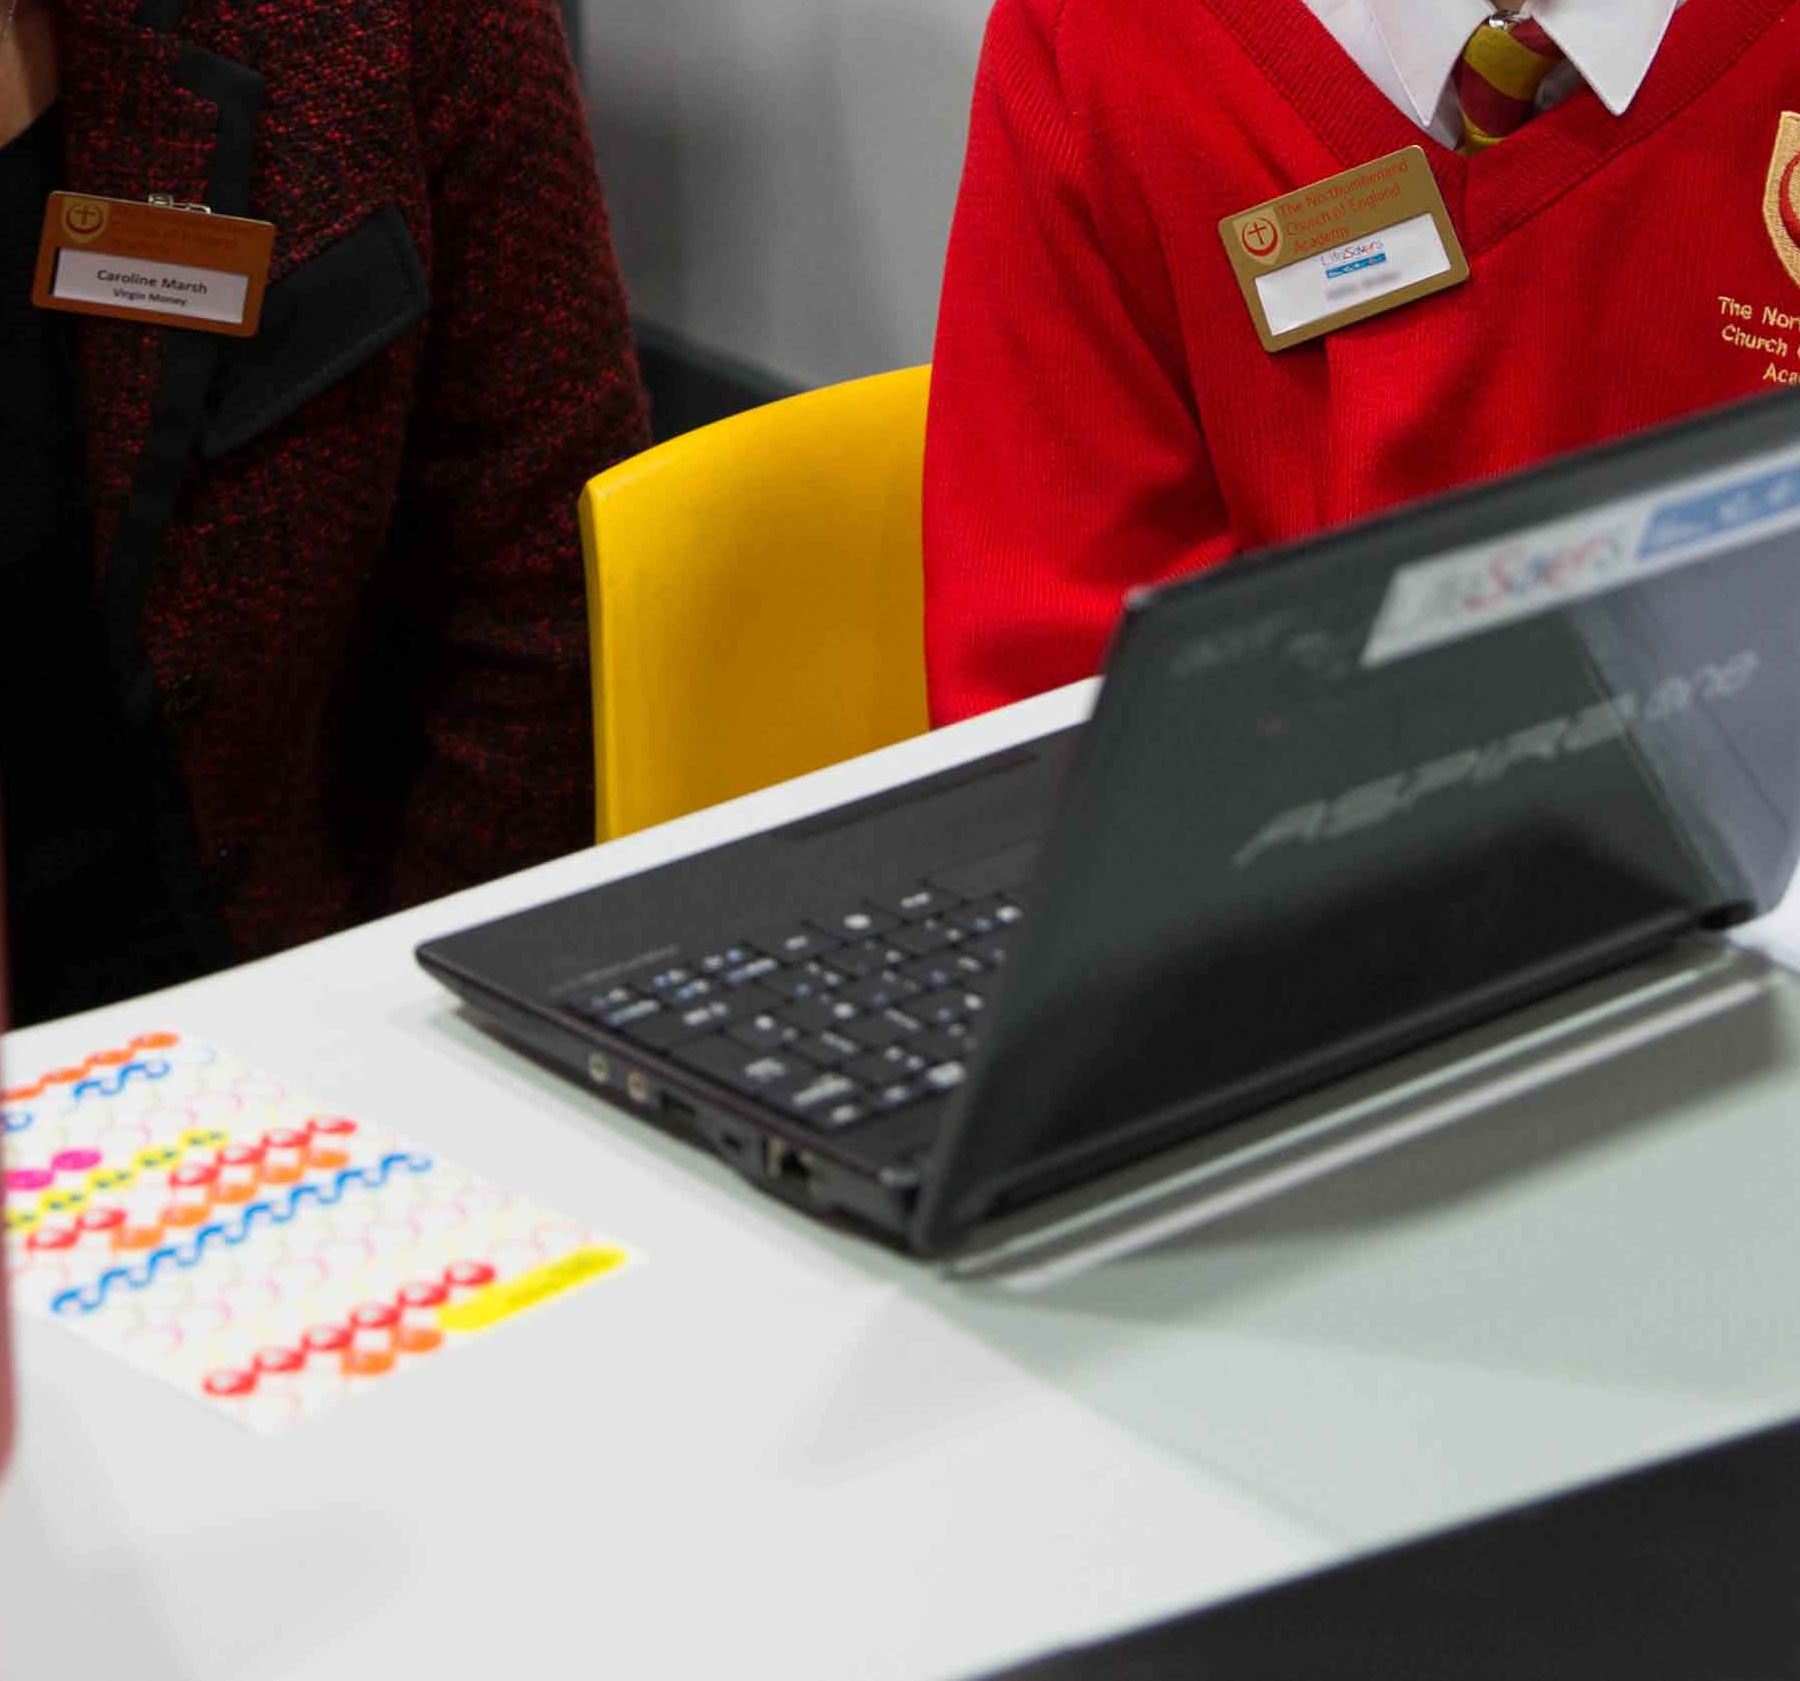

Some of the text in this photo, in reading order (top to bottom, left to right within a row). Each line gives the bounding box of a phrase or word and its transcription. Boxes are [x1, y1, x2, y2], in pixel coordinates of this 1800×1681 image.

[97, 269, 208, 295] Caroline Marsh
[112, 288, 187, 307] Virgin Money
[1717, 296, 1753, 319] The
[1721, 324, 1789, 358] Church
